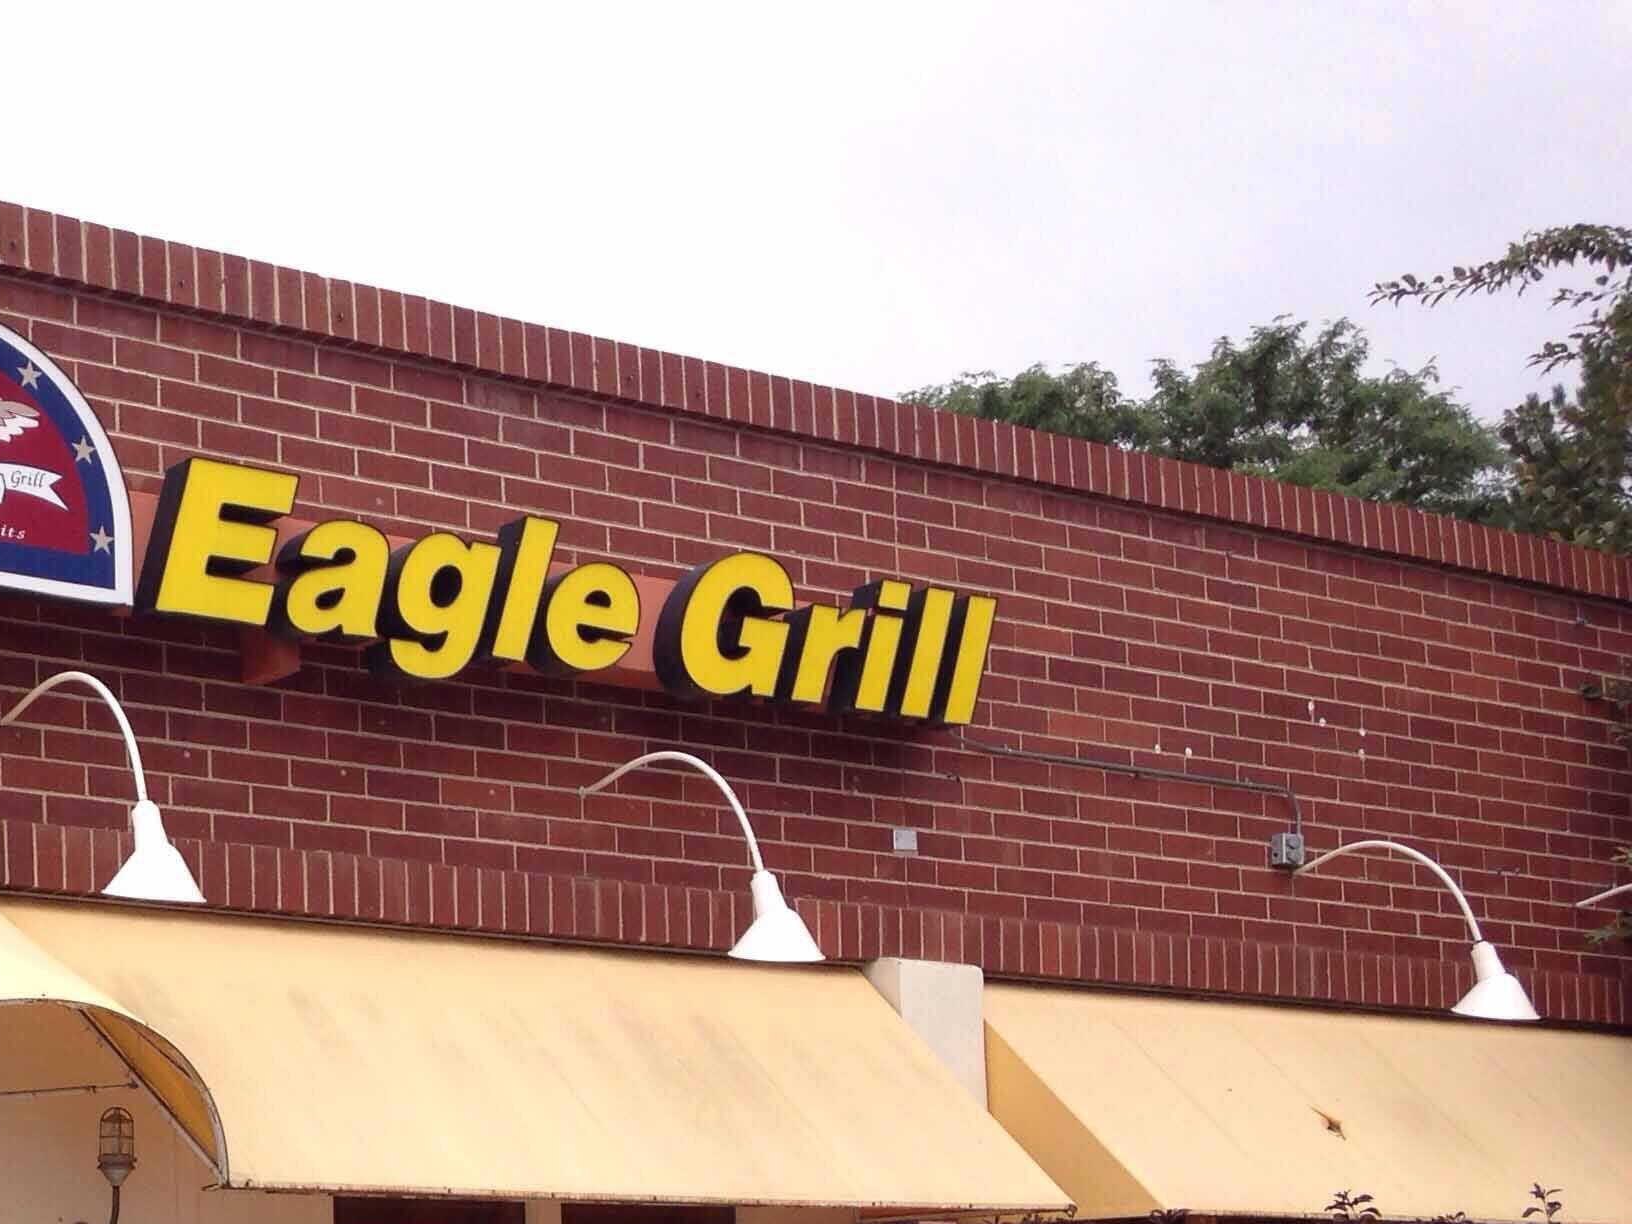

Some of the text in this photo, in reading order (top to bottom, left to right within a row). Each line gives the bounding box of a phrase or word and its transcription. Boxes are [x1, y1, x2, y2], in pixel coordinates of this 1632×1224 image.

[10, 470, 46, 489] Grill
[154, 456, 998, 726] Eagle Grill
